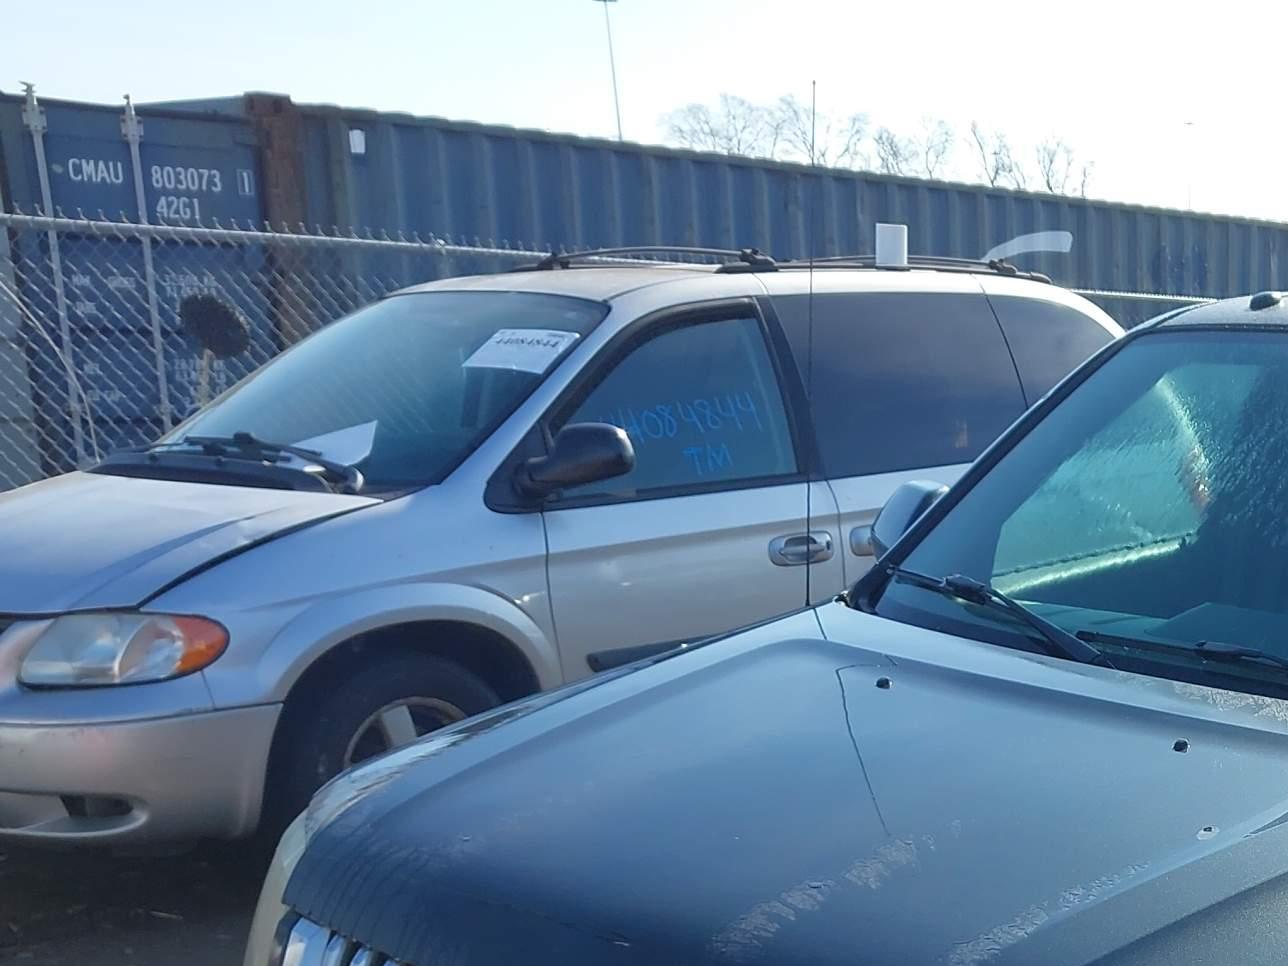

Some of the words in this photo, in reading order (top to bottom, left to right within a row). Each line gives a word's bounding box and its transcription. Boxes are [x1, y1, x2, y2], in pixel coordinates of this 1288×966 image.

[68, 158, 124, 184] CMAU
[151, 165, 223, 193] 803073
[156, 196, 200, 220] 42G1
[683, 442, 734, 475] TM
